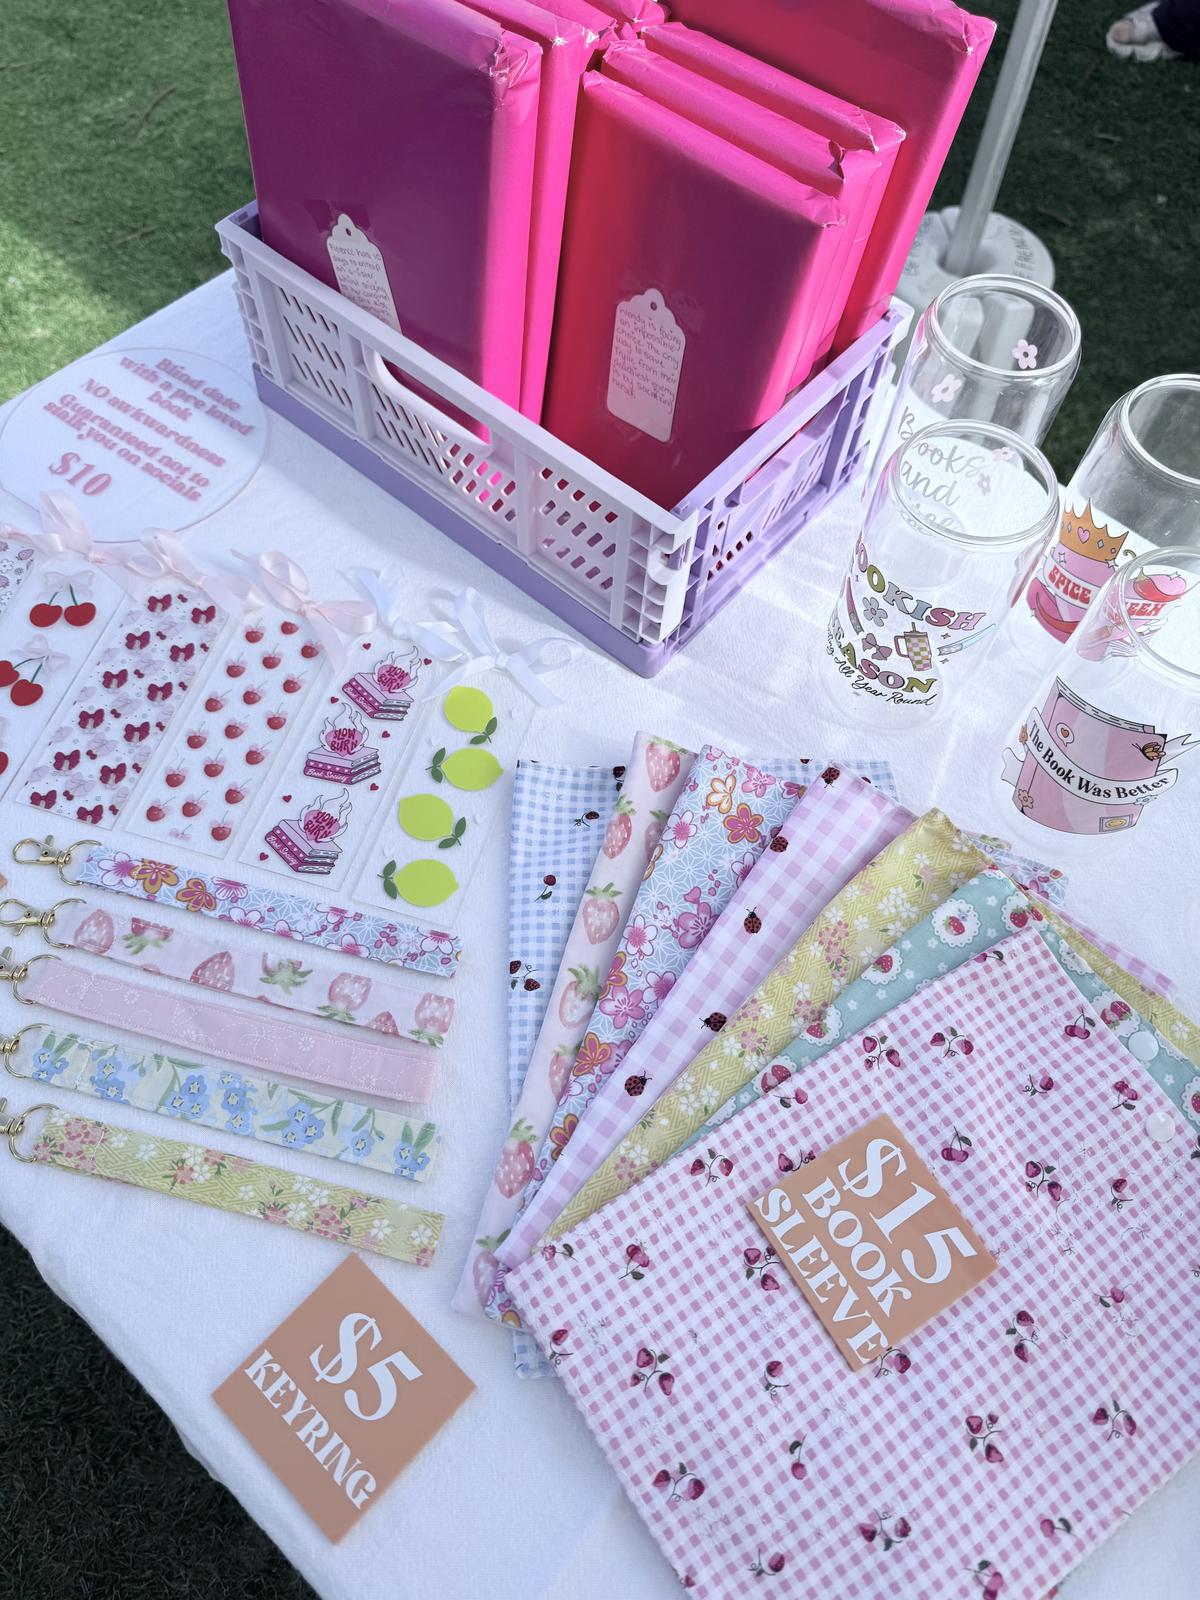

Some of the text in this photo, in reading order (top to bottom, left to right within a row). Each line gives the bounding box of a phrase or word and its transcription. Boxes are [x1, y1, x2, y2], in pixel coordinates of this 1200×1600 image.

[619, 318, 631, 329] an
[648, 317, 658, 332] is
[659, 326, 682, 352] facing
[638, 358, 659, 375] from
[643, 353, 666, 369] save
[662, 352, 680, 370] only
[120, 356, 256, 436] with a pre loved
[147, 390, 192, 422] book
[155, 358, 241, 411] Blind date
[60, 393, 210, 488] Guaranteed not to
[80, 378, 226, 467] NO awkwardness
[44, 402, 202, 502] stalk you on socials
[48, 451, 113, 496] $10
[901, 461, 961, 507] and
[1048, 564, 1092, 605] SPICE
[377, 673, 405, 694] BURN
[386, 665, 410, 681] SLOW
[834, 656, 938, 707] All Year Round
[330, 739, 358, 755] BURN
[333, 728, 356, 741] SLOW
[1029, 720, 1170, 800] The Book Was Better
[303, 820, 332, 843] BURN
[313, 811, 338, 830] SLOW
[837, 1137, 979, 1285] $15
[801, 1176, 913, 1318] BOOK
[753, 1187, 889, 1365] SLEEVE
[309, 1311, 424, 1422] $5
[244, 1348, 377, 1510] KEYRING
